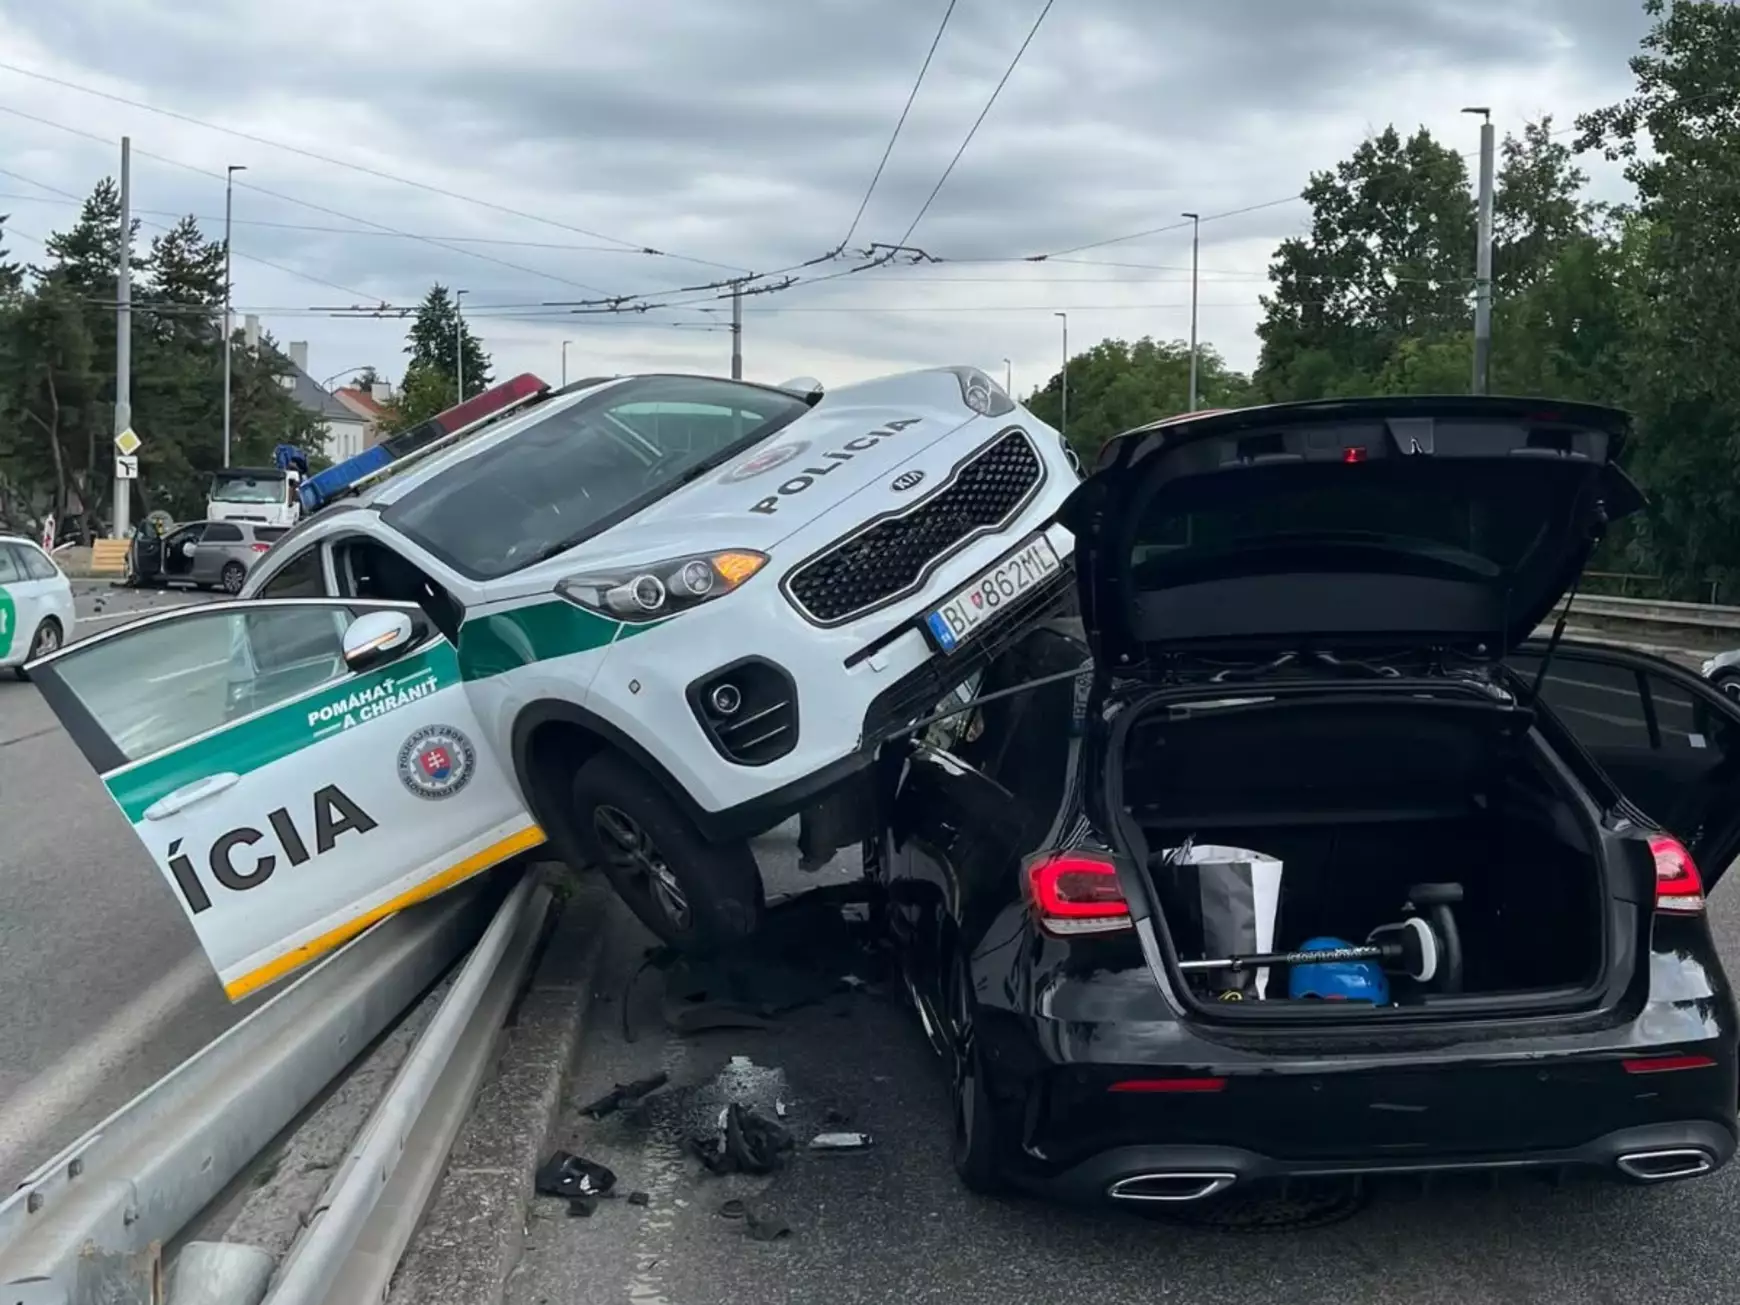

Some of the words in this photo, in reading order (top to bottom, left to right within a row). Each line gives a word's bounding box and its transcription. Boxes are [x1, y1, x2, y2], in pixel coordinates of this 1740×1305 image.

[748, 417, 924, 515] POLÍCIA
[893, 471, 923, 490] KIA
[943, 599, 979, 636] BL
[981, 545, 1055, 607] 862ML
[307, 678, 396, 728] POMÁHAŤ
[343, 713, 357, 729] A
[359, 675, 438, 721] CHRÁNIŤ
[166, 783, 379, 916] ÍCIA
